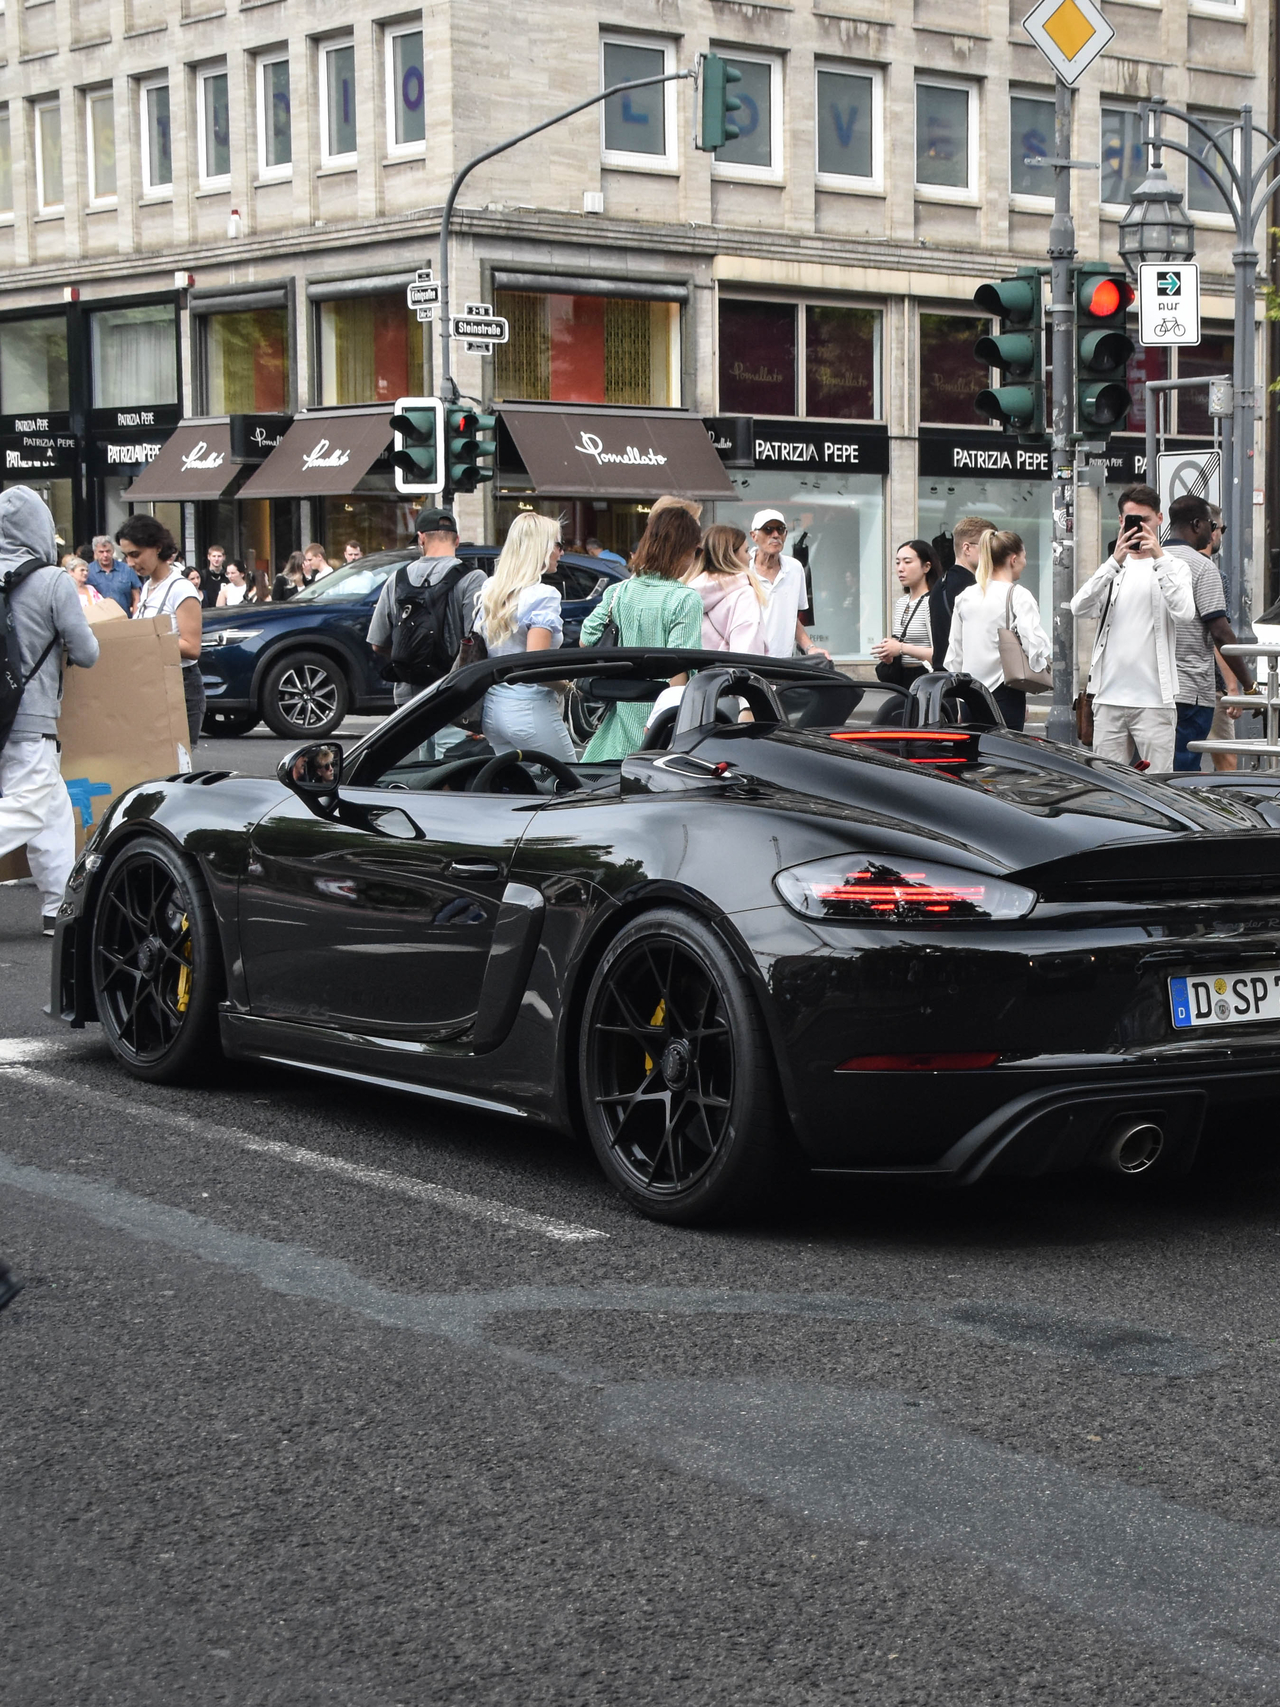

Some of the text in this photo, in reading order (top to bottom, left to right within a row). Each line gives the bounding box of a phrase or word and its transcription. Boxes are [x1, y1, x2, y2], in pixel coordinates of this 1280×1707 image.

[1158, 302, 1180, 311] nur
[458, 321, 501, 336] Steinstraße
[729, 361, 783, 384] Pomellato
[816, 366, 868, 388] Pomellato
[15, 418, 49, 432] PATRIZIA PEPE
[117, 411, 155, 426] PATRIZIA PEPE
[24, 437, 75, 448] PATRIZIA PEPE
[575, 431, 667, 465] Pomellato
[107, 444, 143, 464] PATRIZIA
[755, 439, 859, 463] PATRIZIA PEPE
[953, 448, 1048, 471] PATRIZIA PEPE
[1110, 457, 1124, 468] PEPE
[1213, 919, 1264, 933] Spyder
[1192, 981, 1213, 1019] D
[1232, 977, 1268, 1015] SP
[1178, 1007, 1186, 1018] D
